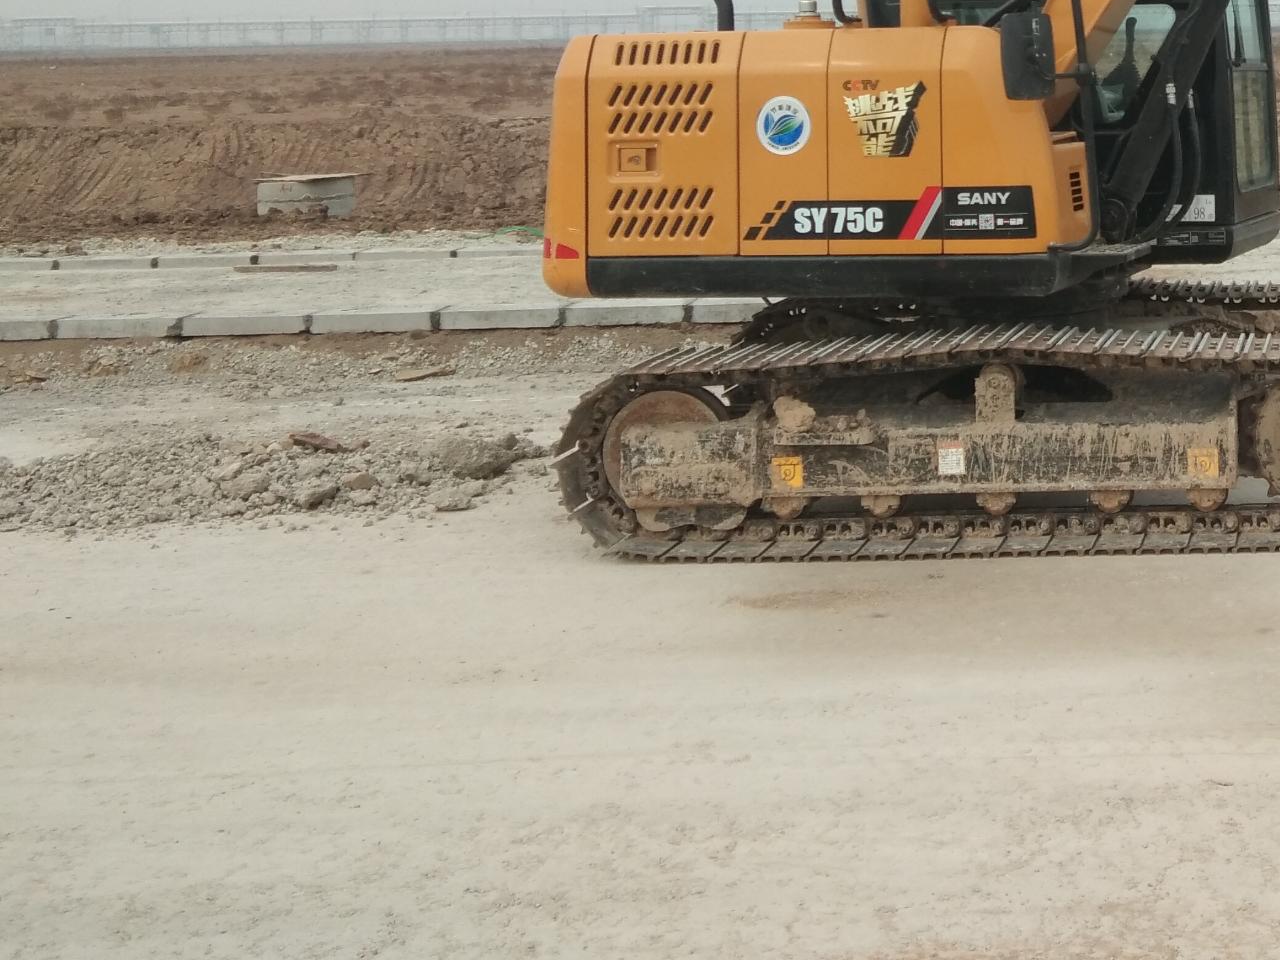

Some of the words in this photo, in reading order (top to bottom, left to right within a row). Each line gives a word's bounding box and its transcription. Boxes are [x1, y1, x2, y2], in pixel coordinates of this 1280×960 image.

[842, 79, 880, 91] CCTV
[957, 192, 1011, 205] SANY
[1193, 207, 1206, 220] 98
